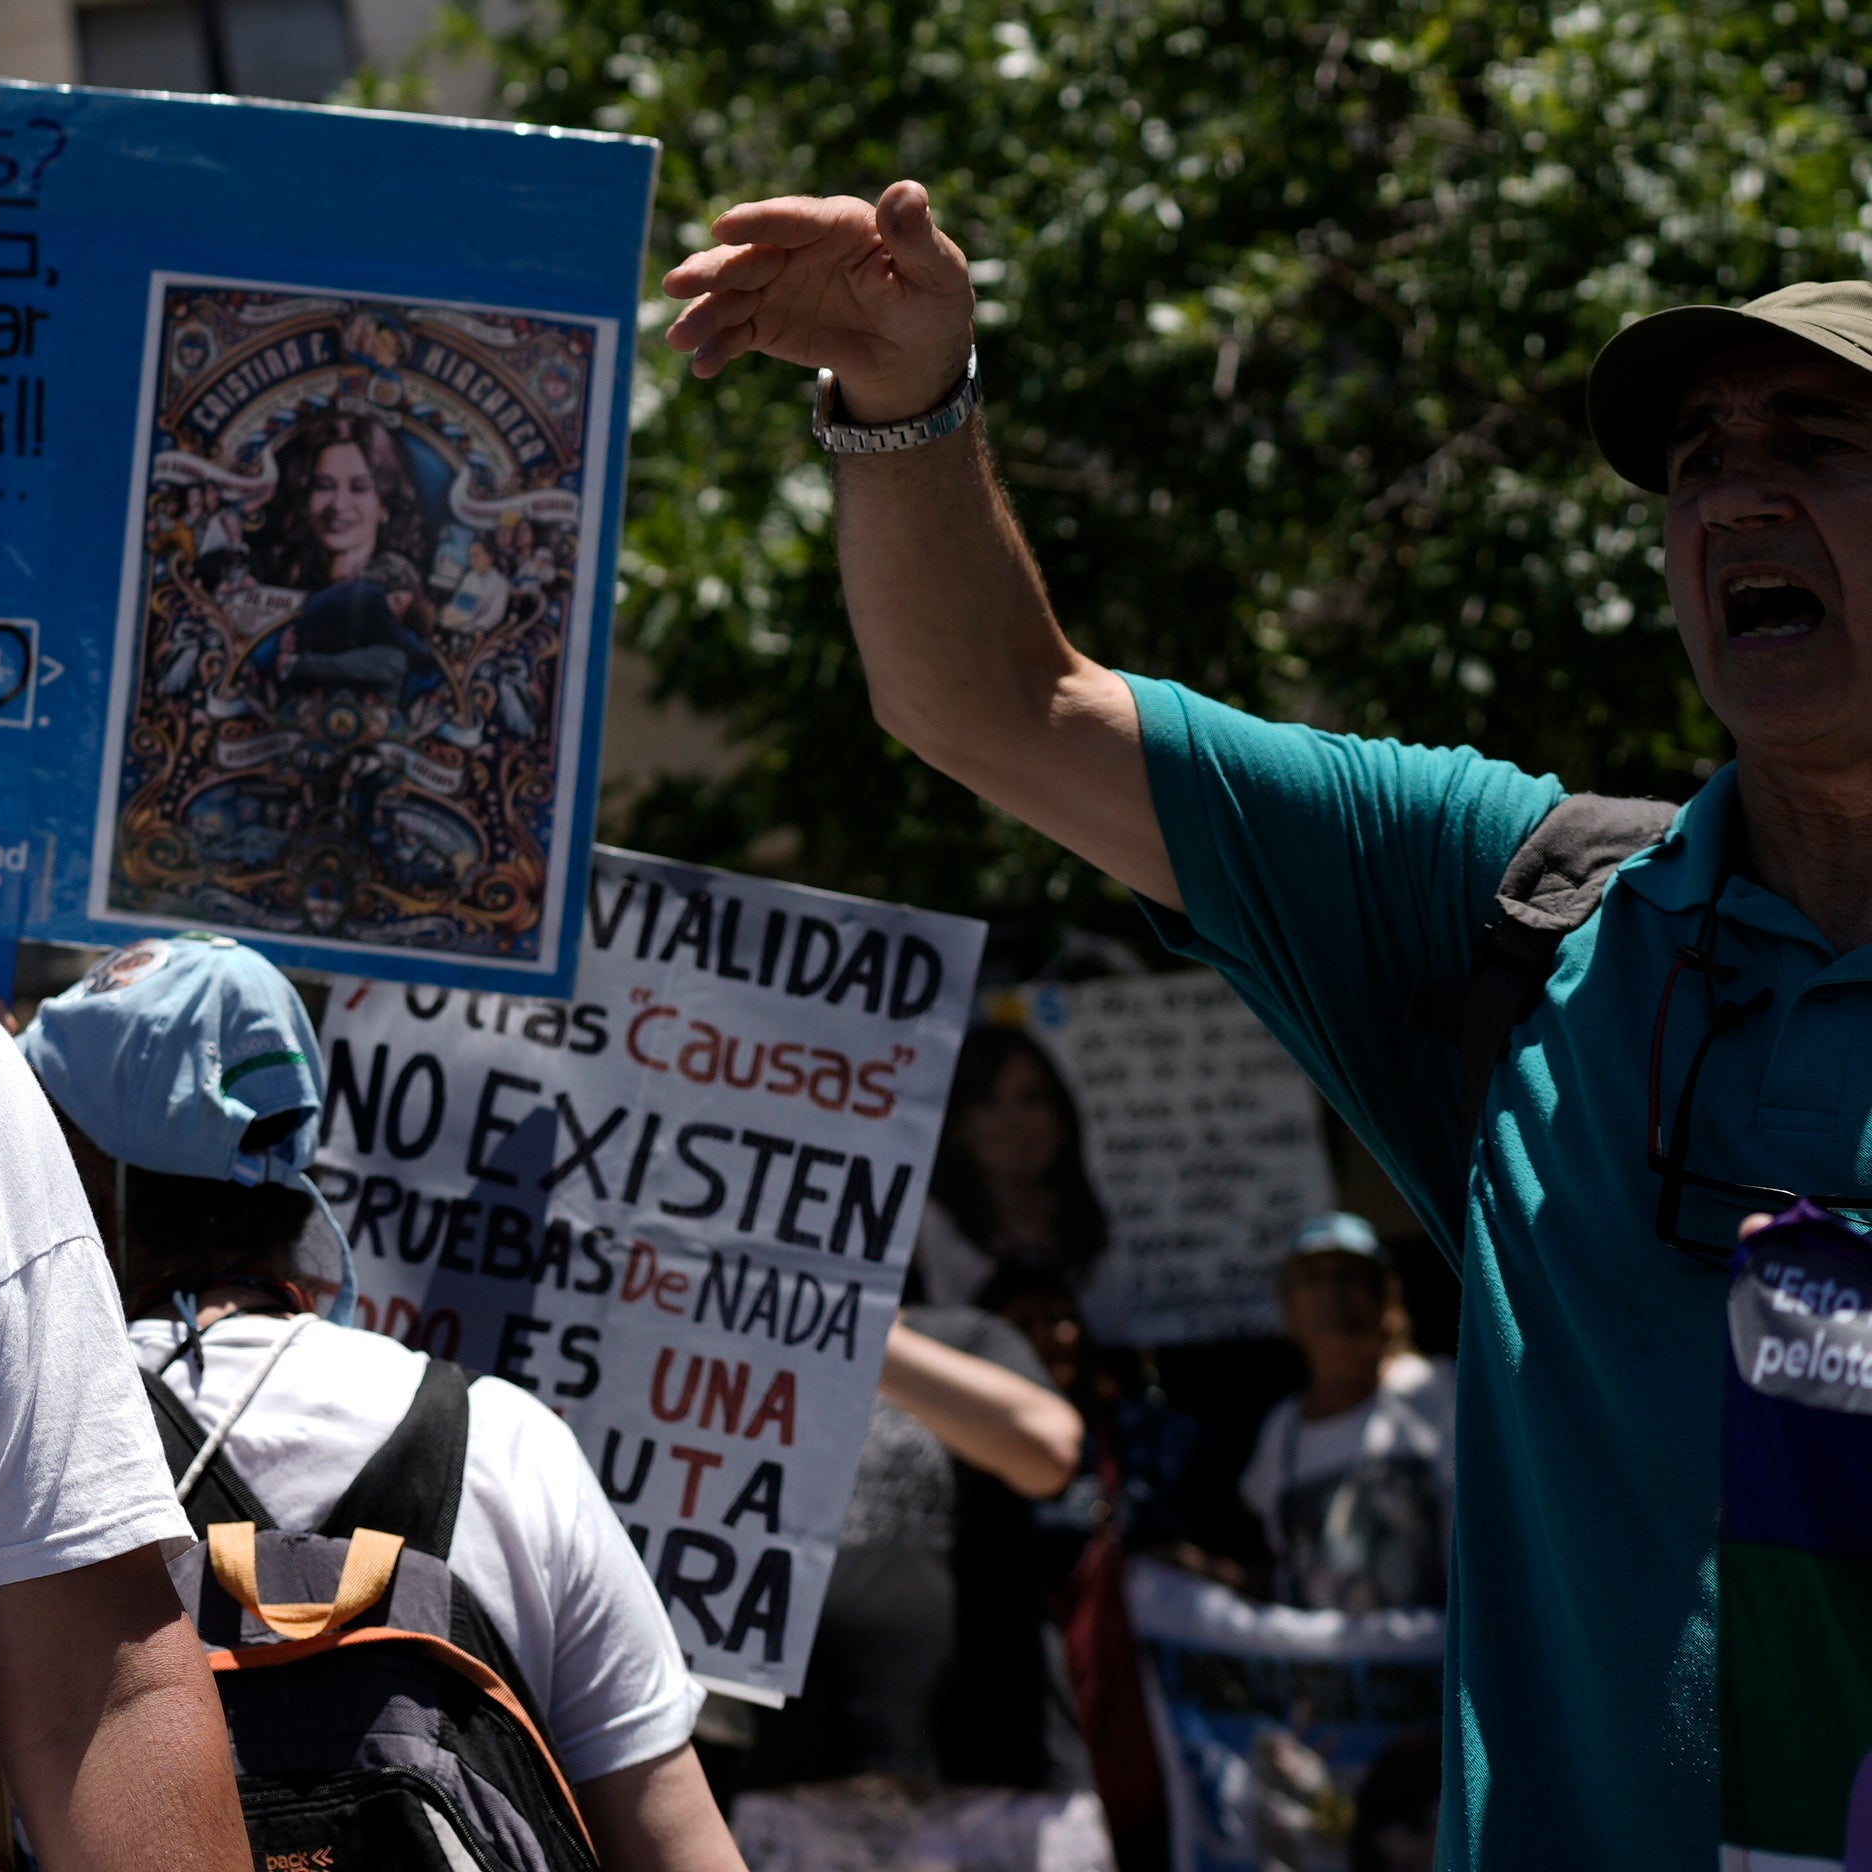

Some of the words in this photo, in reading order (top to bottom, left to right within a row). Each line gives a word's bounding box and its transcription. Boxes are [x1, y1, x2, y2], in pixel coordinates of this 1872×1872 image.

[587, 869, 944, 1021] VIALIDAD
[318, 1038, 446, 1160] NO
[466, 1068, 913, 1264] EXISTEN
[694, 1249, 863, 1362] NADA
[494, 1313, 602, 1399] ES
[649, 1346, 796, 1447] UNA
